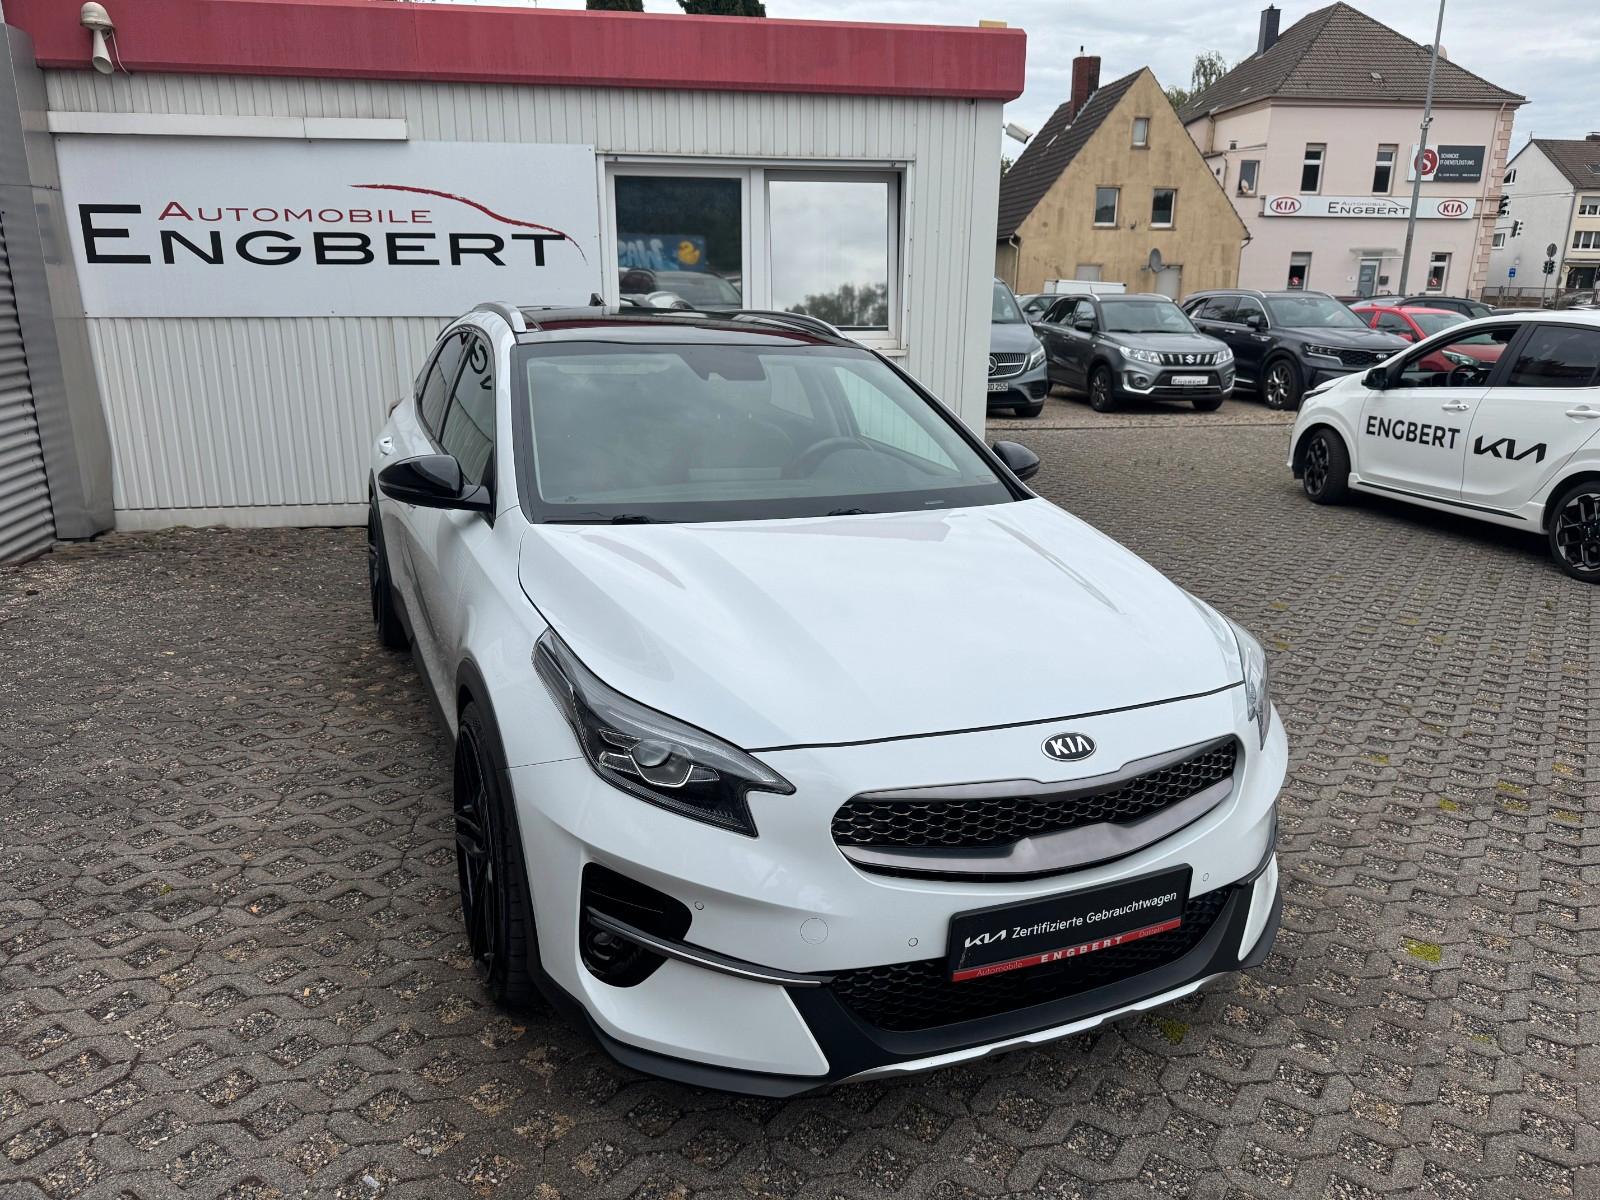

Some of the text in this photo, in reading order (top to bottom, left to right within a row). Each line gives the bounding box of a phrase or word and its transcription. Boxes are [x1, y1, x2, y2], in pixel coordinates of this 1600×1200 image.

[158, 201, 433, 224] AUTOMOBILE
[1275, 199, 1297, 210] KIA
[1327, 201, 1410, 215] ENGBERT
[1442, 202, 1463, 213] KIA
[78, 203, 566, 267] ENGBERT
[1366, 415, 1460, 449] ENGBERT
[1473, 435, 1547, 464] KIA
[1048, 735, 1092, 756] KIA
[964, 892, 1177, 948] KIA Zertifizierte Gebrauchtwagen
[976, 961, 1023, 977] Automobile
[1041, 936, 1123, 963] ENGBERT
